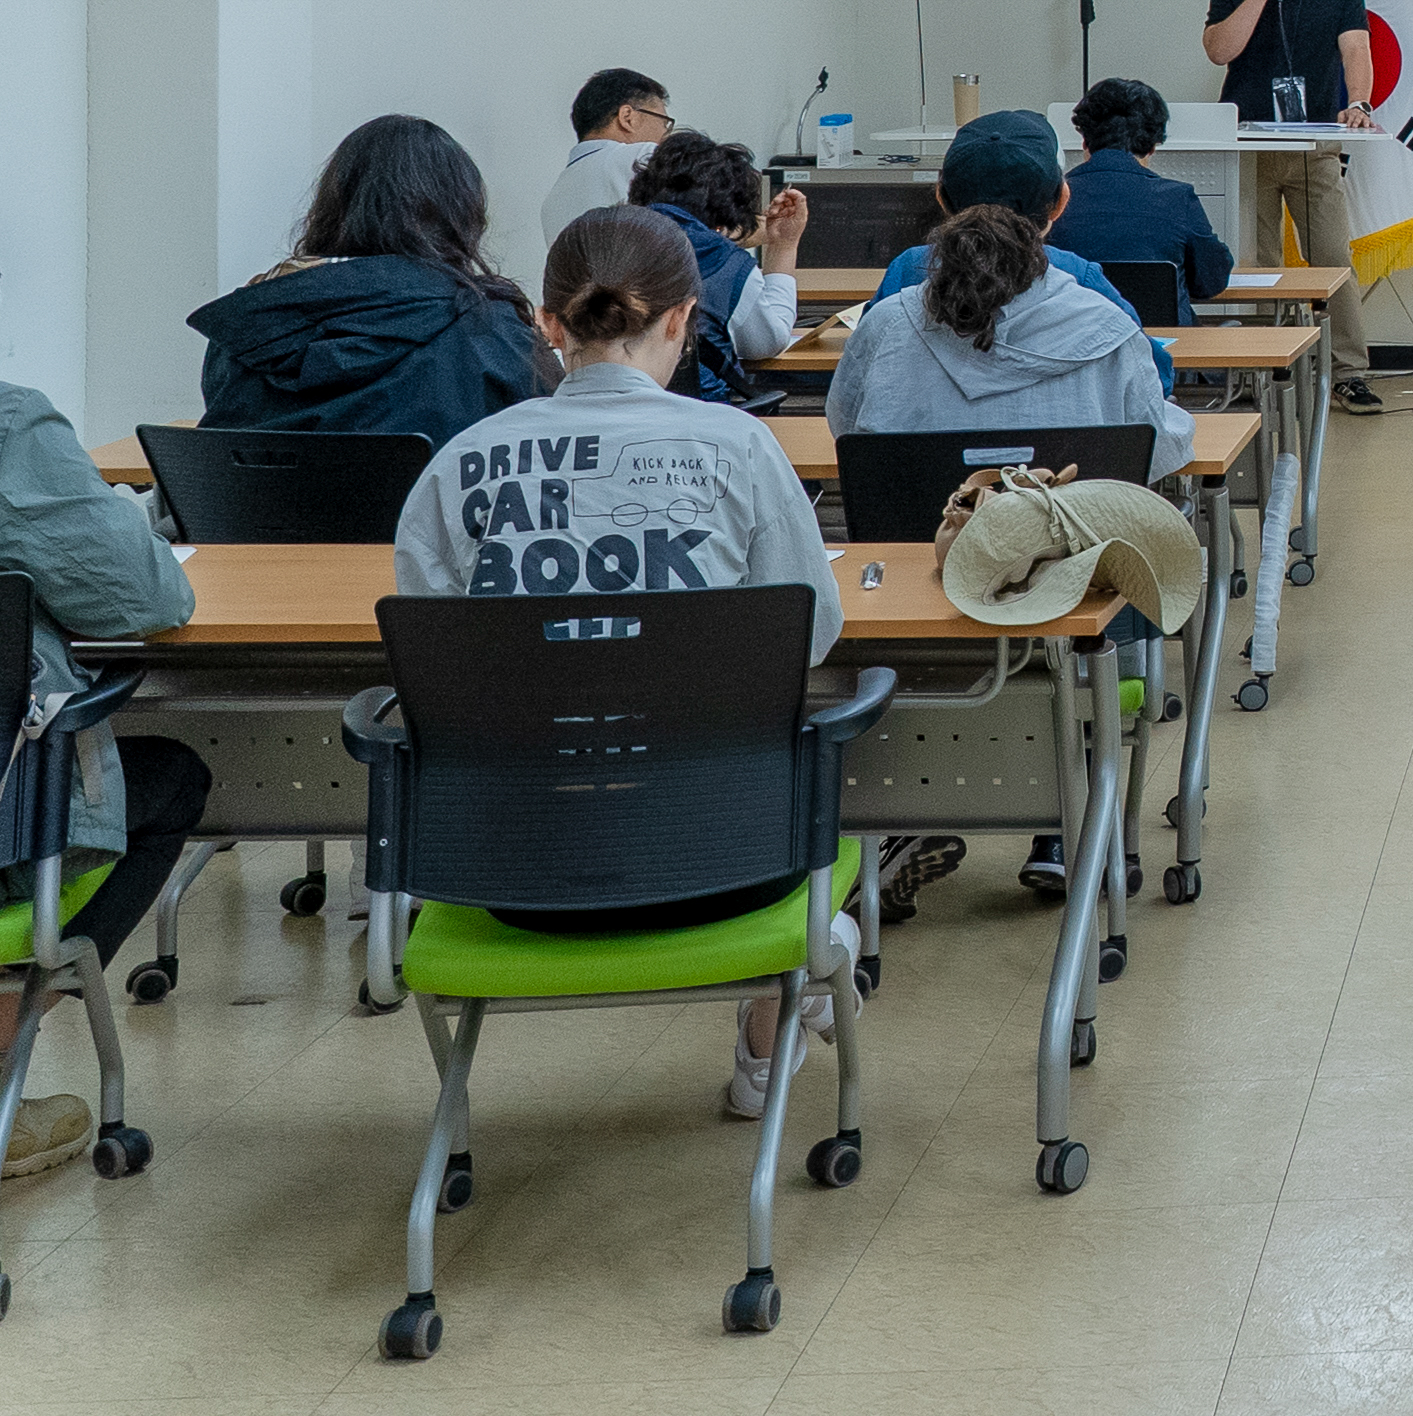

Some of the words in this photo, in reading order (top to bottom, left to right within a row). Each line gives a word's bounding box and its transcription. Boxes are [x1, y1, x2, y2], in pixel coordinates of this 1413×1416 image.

[459, 435, 600, 490] DRIVE
[627, 475, 658, 486] AND
[665, 472, 708, 488] RELAX
[632, 456, 664, 472] KICK
[671, 457, 704, 471] BACK
[461, 477, 570, 542] CAR
[468, 528, 713, 595] BOOK
